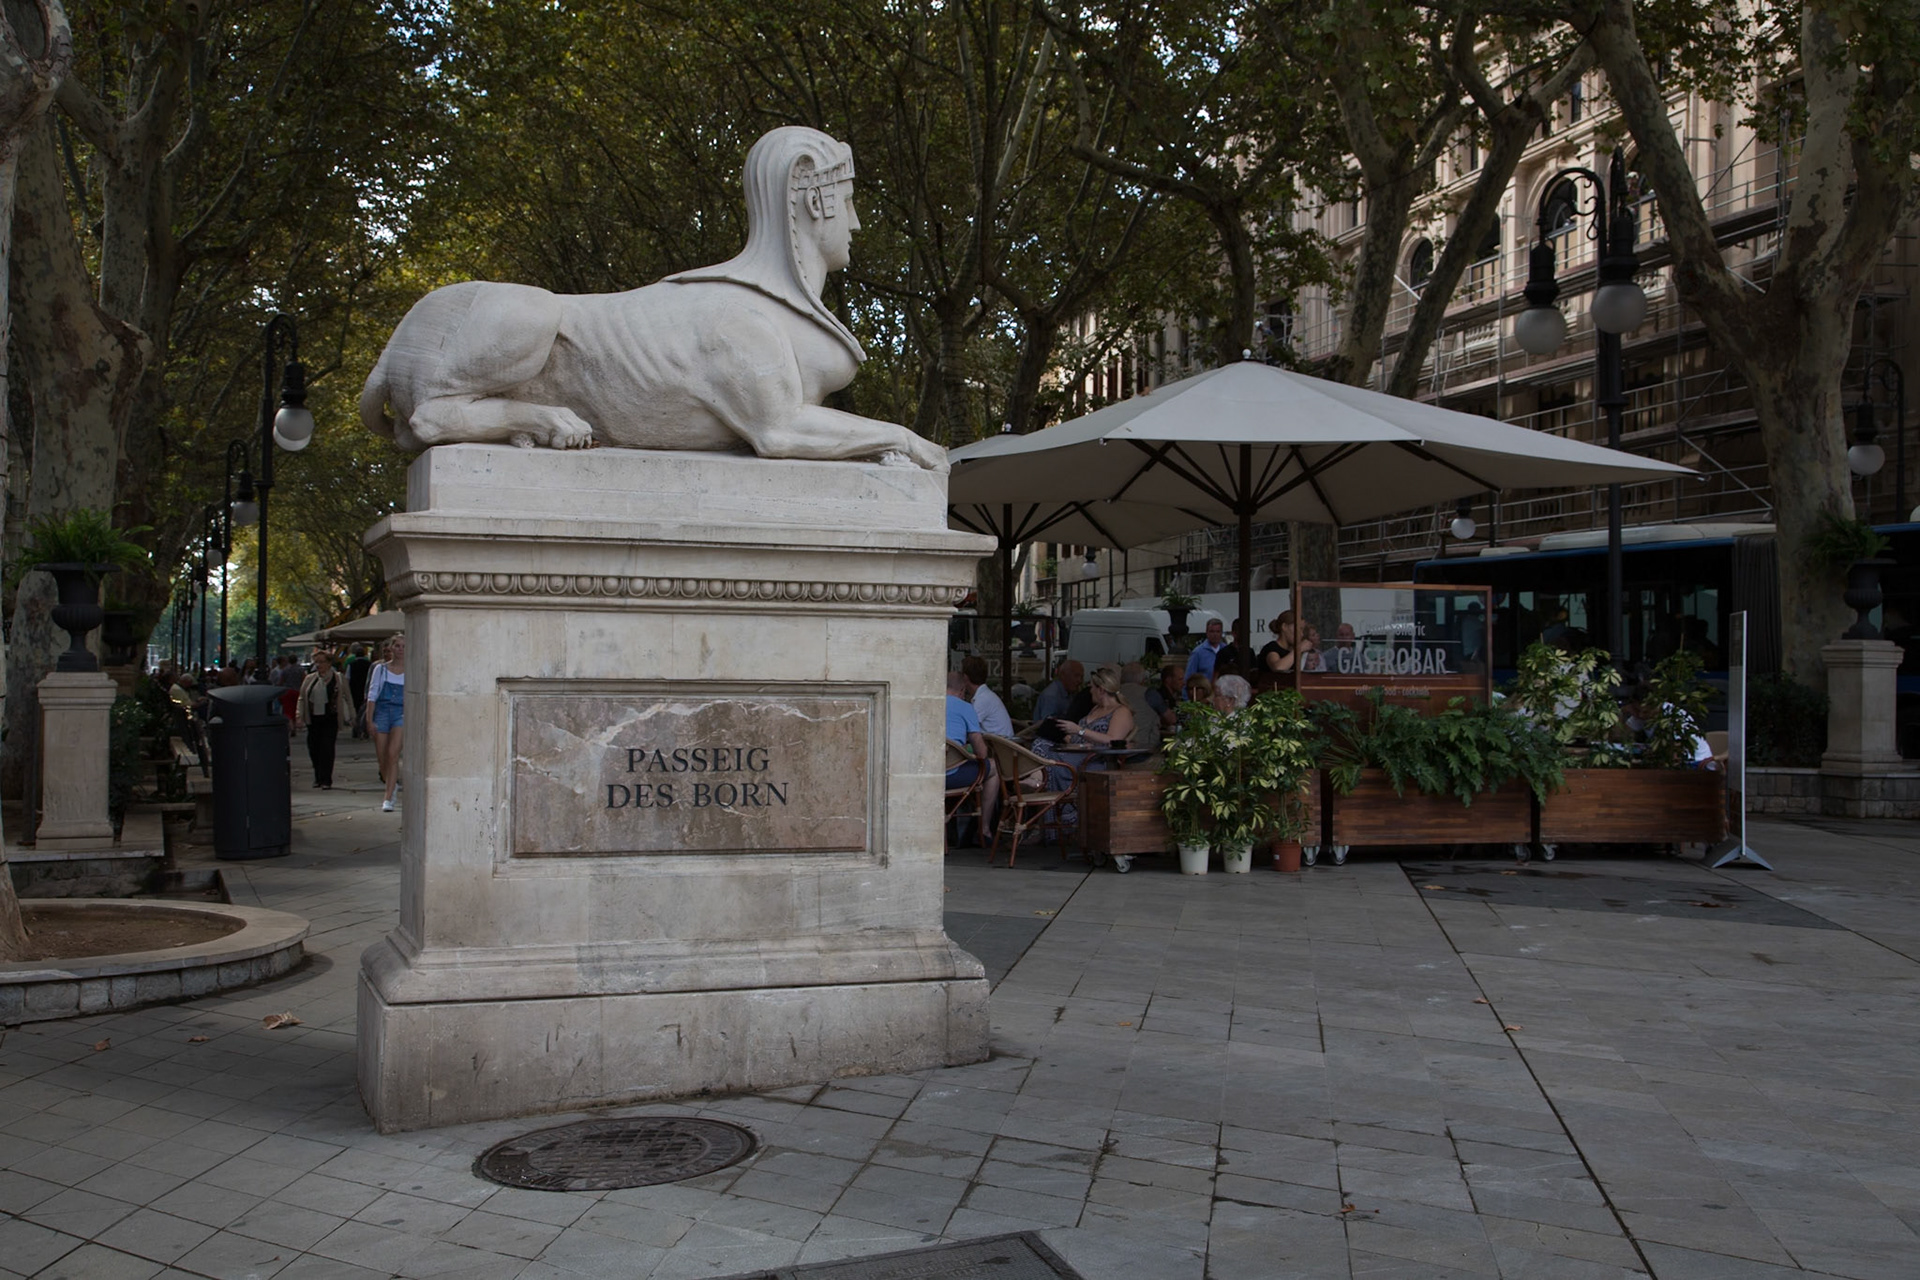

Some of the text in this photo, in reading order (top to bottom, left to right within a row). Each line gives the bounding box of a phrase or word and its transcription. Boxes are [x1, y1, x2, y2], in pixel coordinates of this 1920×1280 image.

[1337, 647, 1447, 675] GASTROBAR
[627, 748, 770, 773] PASSEIG
[606, 782, 789, 809] DES BORN
